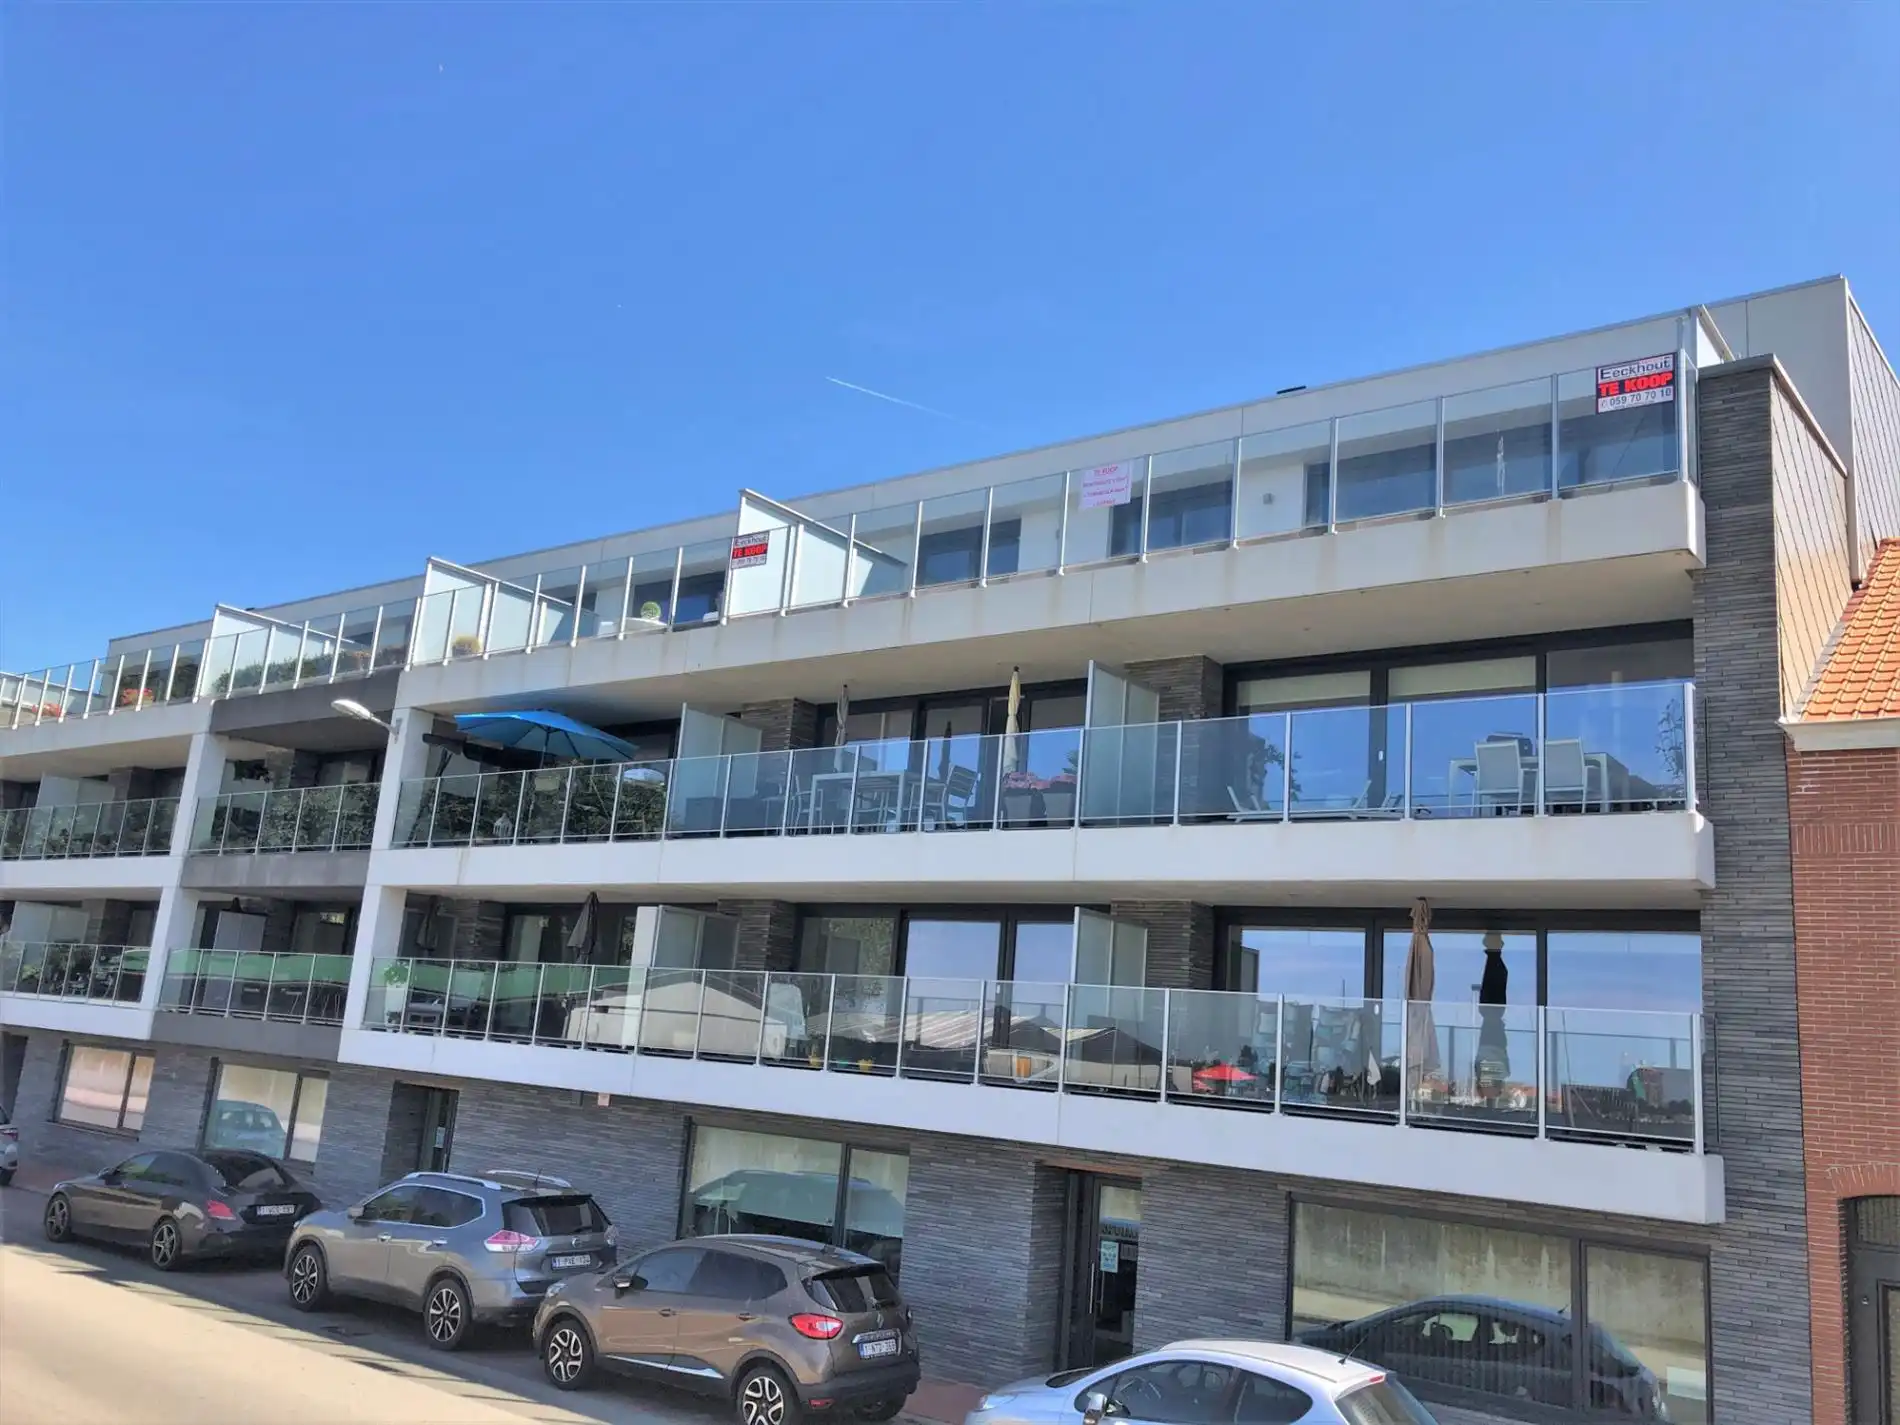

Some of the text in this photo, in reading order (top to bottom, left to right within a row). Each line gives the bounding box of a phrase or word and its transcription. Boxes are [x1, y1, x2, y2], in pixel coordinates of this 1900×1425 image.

[1600, 357, 1671, 380] Eeckhout
[1599, 372, 1673, 397] TE KOOP
[1609, 396, 1627, 407] 059
[1630, 393, 1642, 403] 70
[1644, 390, 1657, 401] 70
[1661, 387, 1672, 398] 10
[733, 545, 767, 558] TE KOOP
